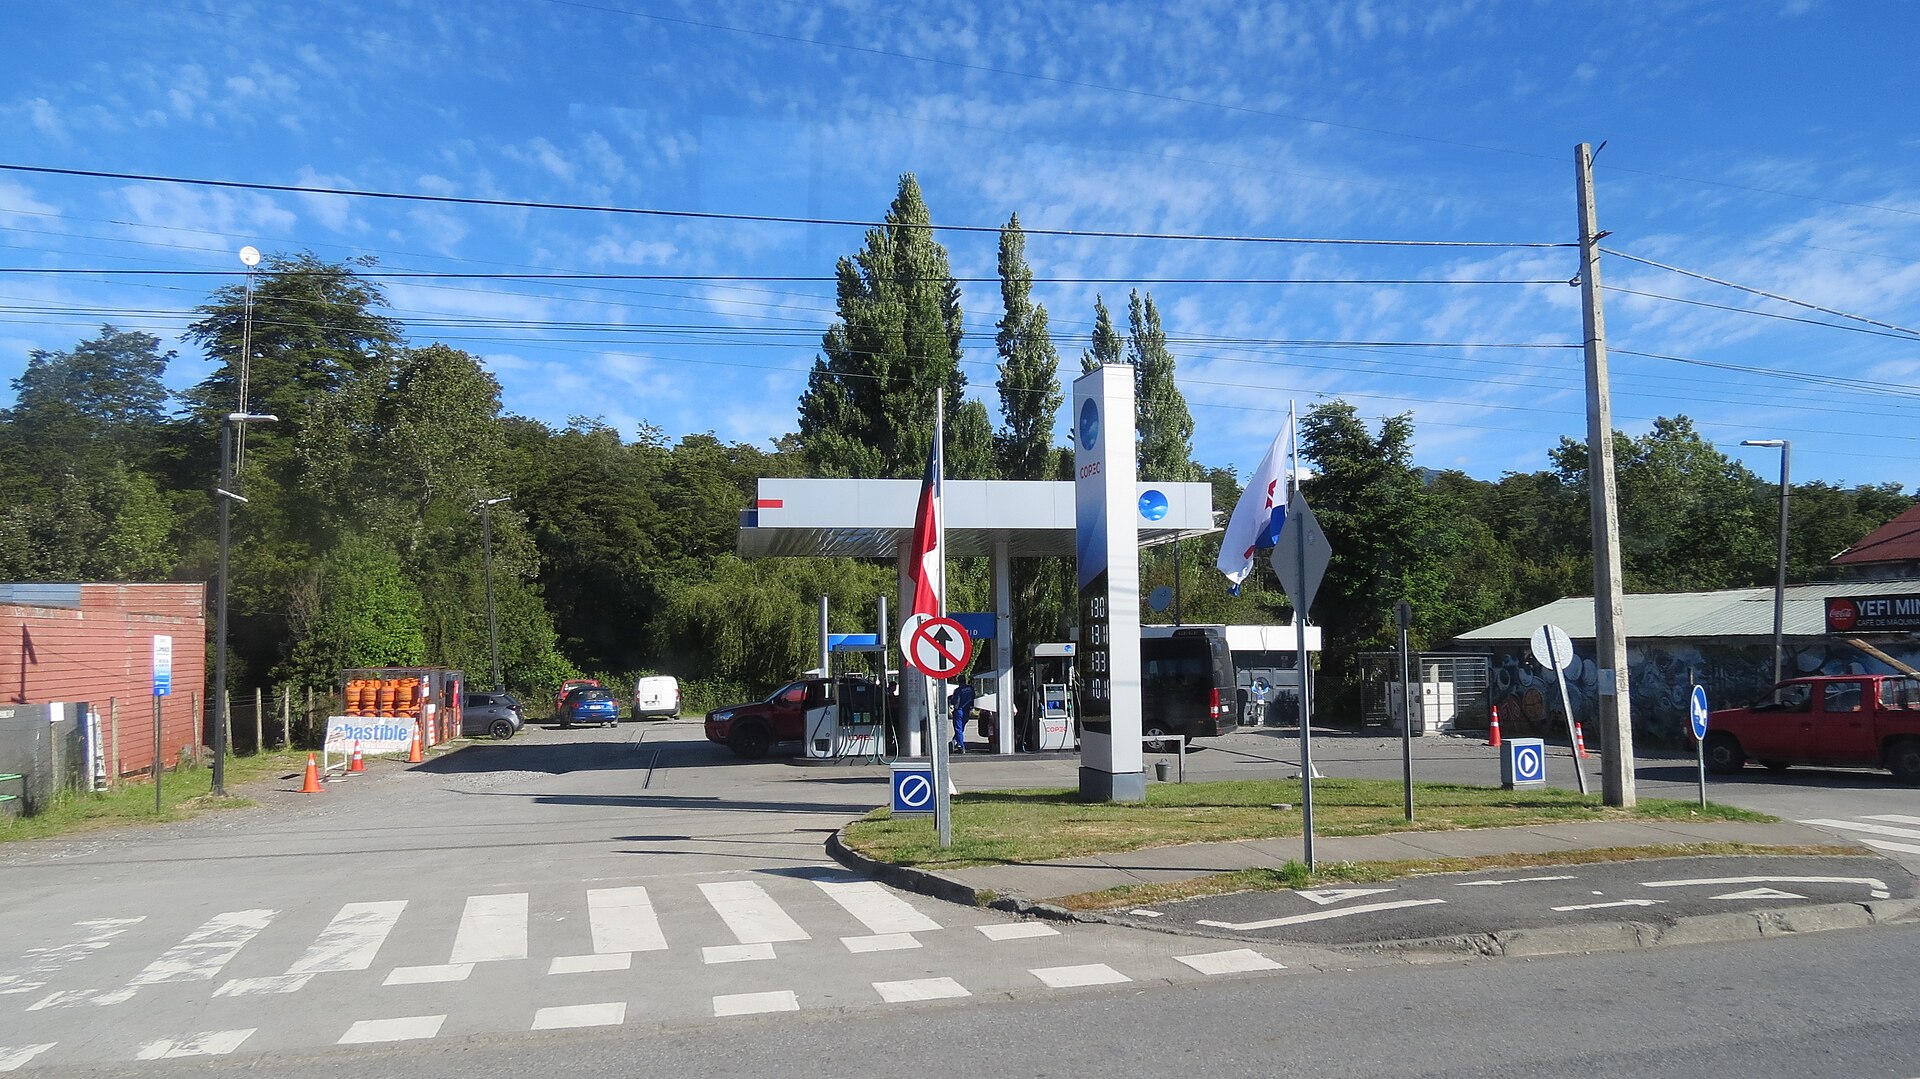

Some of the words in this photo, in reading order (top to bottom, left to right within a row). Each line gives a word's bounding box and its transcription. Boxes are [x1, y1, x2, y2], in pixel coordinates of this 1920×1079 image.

[1079, 461, 1101, 479] COPEC
[1856, 600, 1891, 616] YEFI
[1876, 618, 1886, 627] DE
